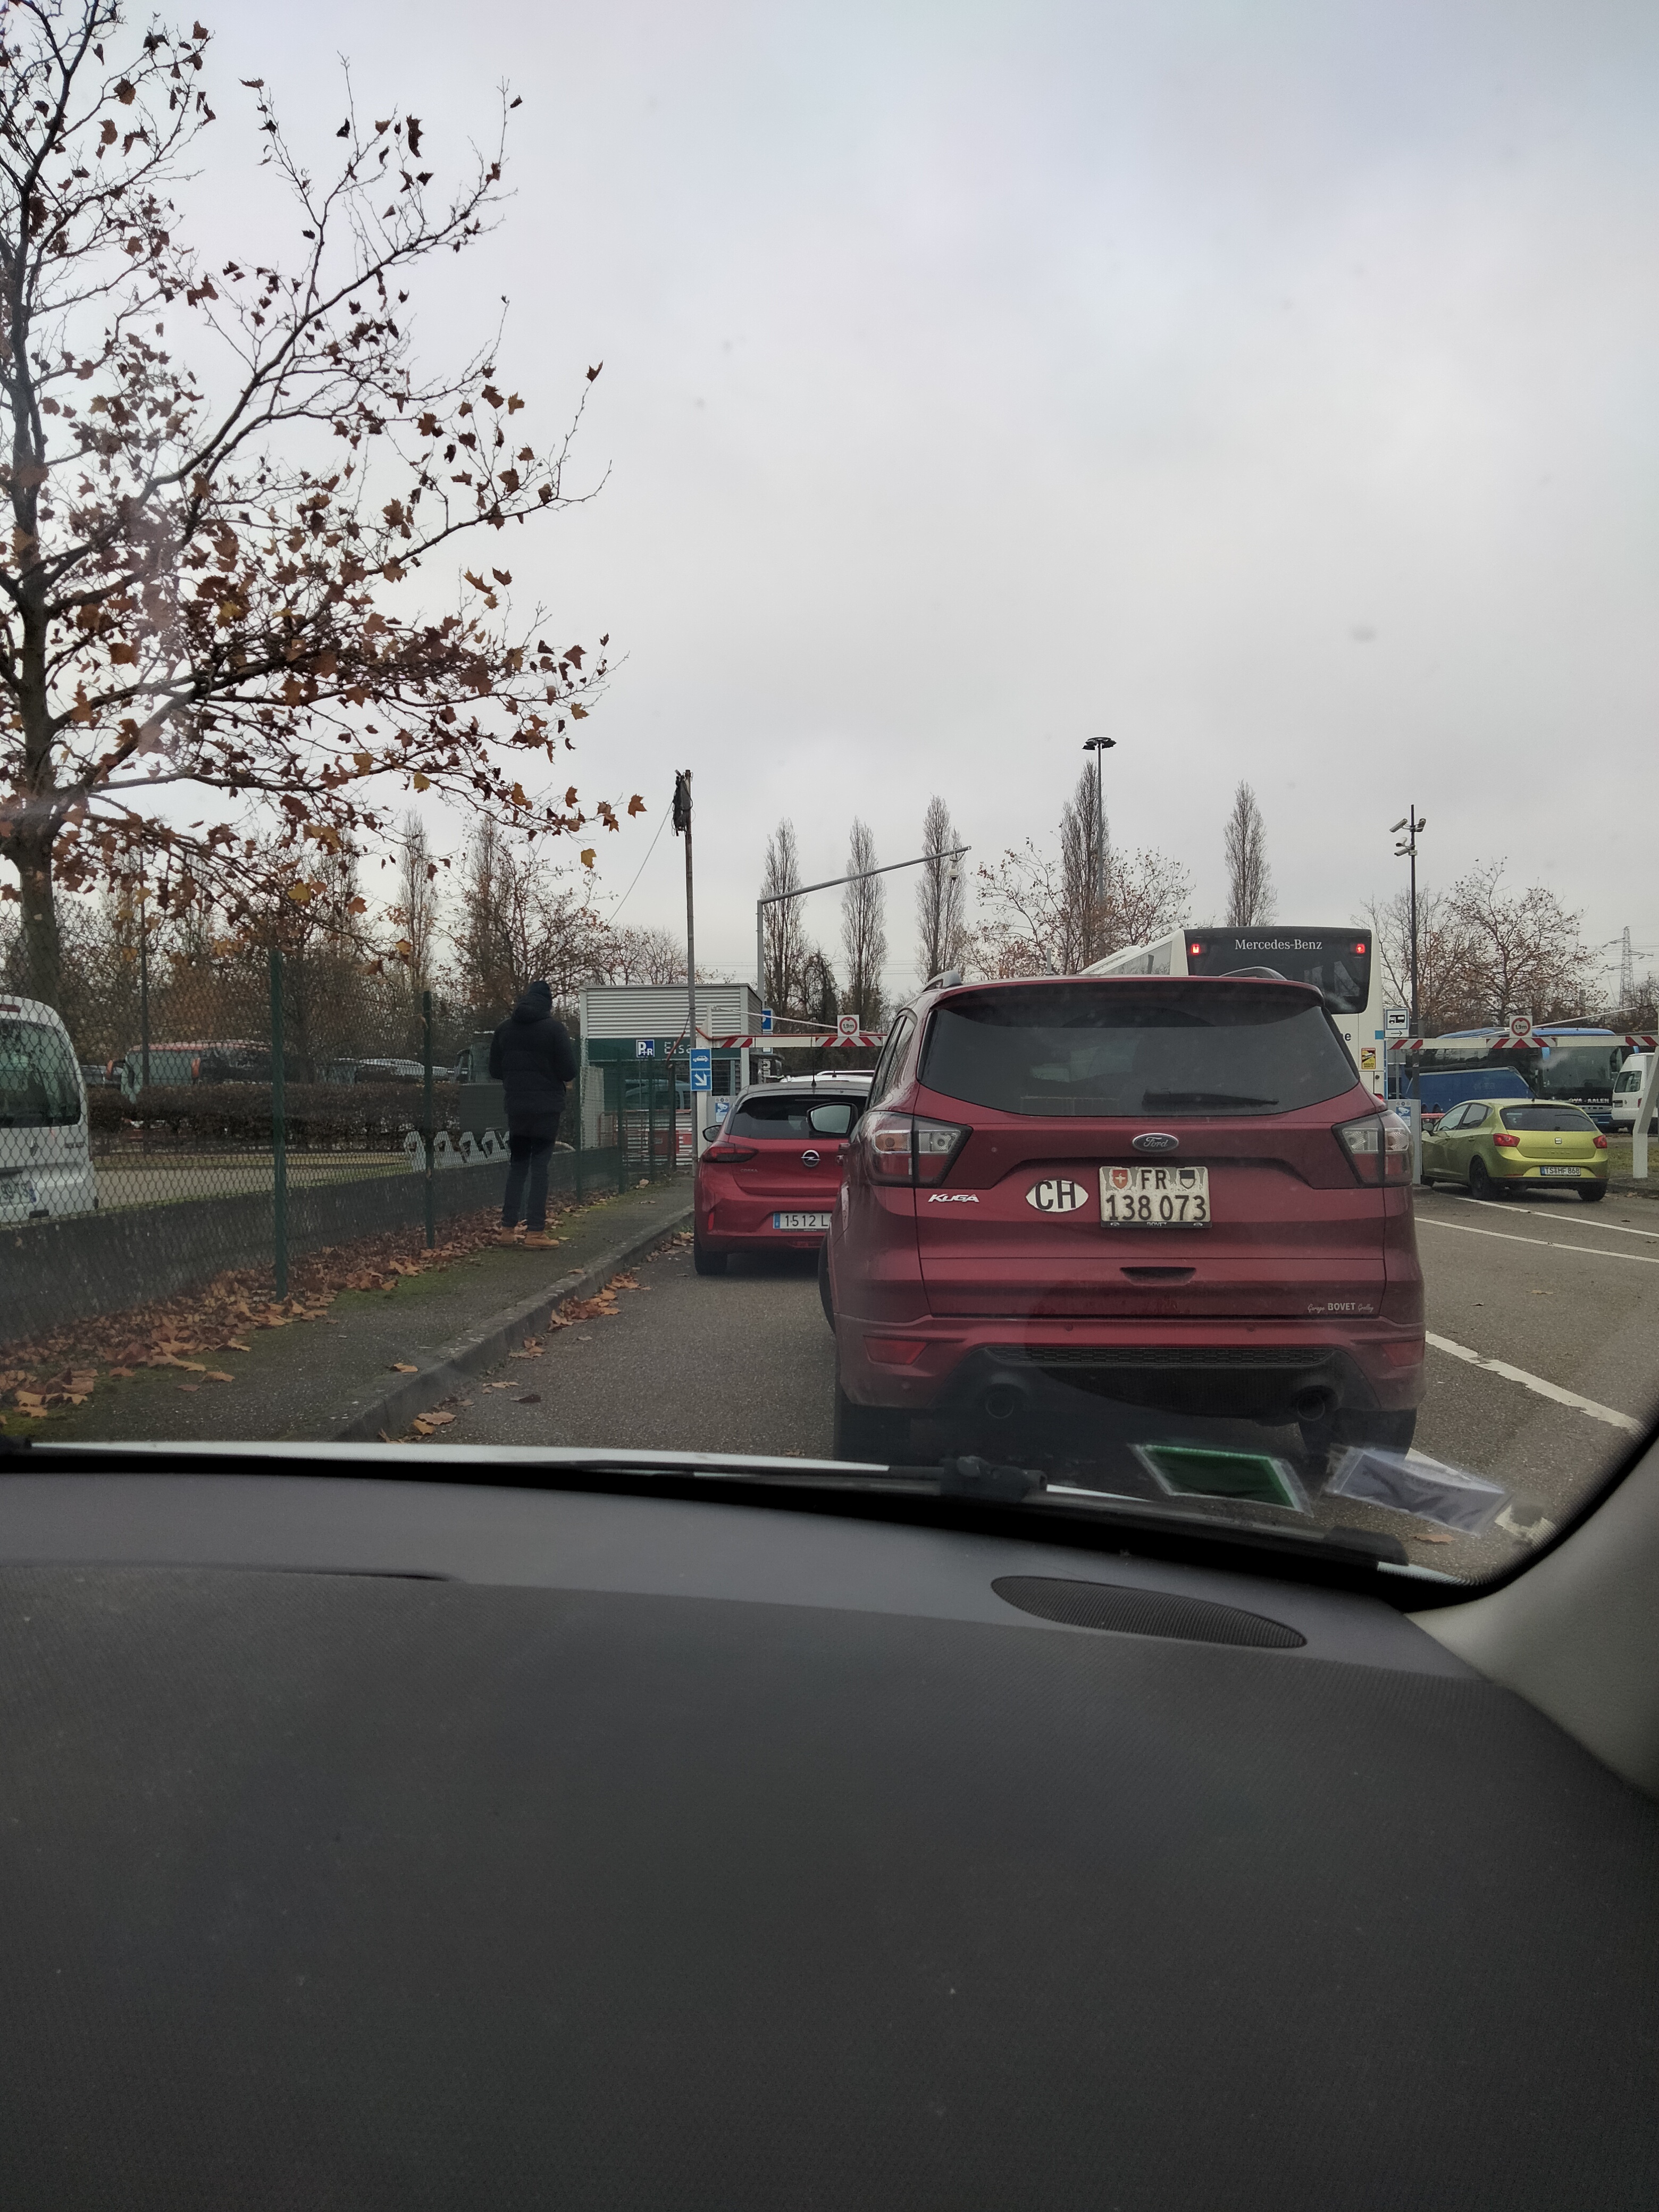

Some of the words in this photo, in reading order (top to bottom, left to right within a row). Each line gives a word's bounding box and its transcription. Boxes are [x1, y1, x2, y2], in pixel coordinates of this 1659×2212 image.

[1235, 939, 1322, 950] Mercedes-Benz
[1143, 1136, 1169, 1147] Ford
[1141, 1169, 1167, 1190] FR
[928, 1194, 980, 1203] KUGA
[1035, 1180, 1077, 1210] CH
[1106, 1195, 1152, 1221] 138
[1160, 1195, 1206, 1221] 073
[785, 1214, 816, 1227] 1512
[1328, 1302, 1356, 1311] BOVET
